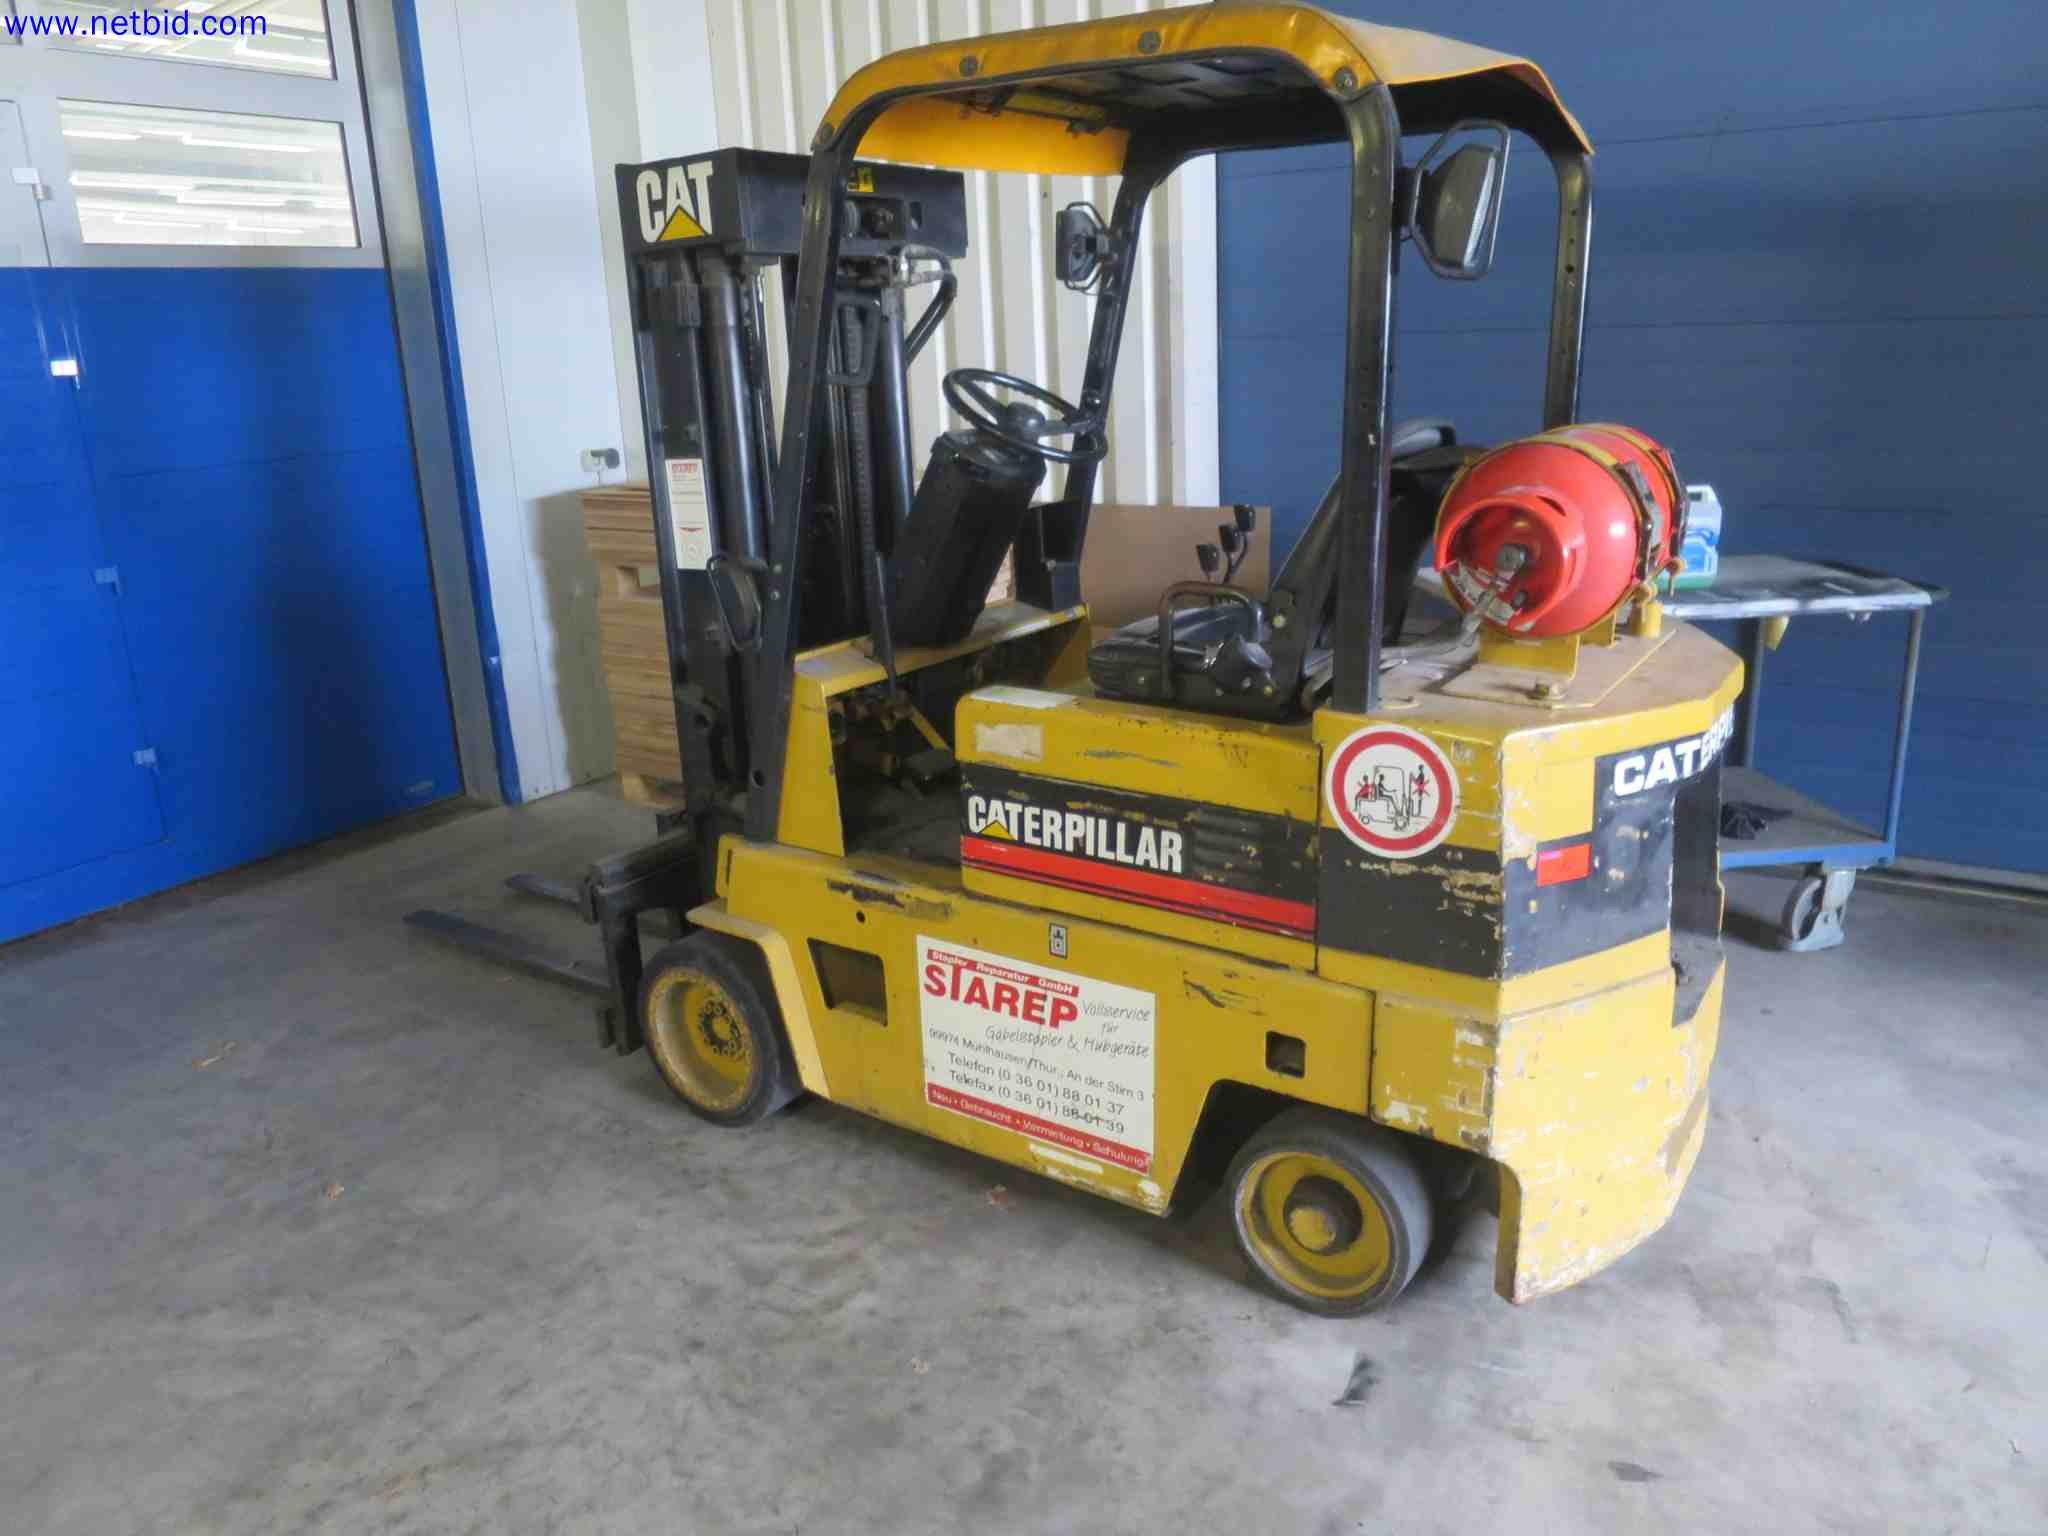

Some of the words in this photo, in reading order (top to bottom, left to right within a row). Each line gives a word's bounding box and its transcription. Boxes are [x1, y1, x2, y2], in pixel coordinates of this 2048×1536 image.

[636, 160, 714, 243] CAT
[967, 795, 1183, 874] CATERPILLAR
[924, 963, 1078, 1029] STAREP
[931, 949, 968, 968] Stapler
[976, 962, 1030, 984] Reparatur
[1037, 976, 1074, 995] GmbH
[1067, 1036, 1080, 1053] &
[948, 1051, 995, 1078] Telefon
[1016, 1071, 1034, 1088] 36
[1037, 1075, 1060, 1097] 01)
[1062, 1085, 1080, 1102] 88
[1085, 1091, 1101, 1108] 01
[1107, 1101, 1126, 1116] 37
[949, 1069, 995, 1093] Telefax
[1015, 1089, 1034, 1106] 36
[1036, 1093, 1060, 1117] 01)
[1066, 1068, 1082, 1082] An
[1084, 1074, 1104, 1089] der
[1022, 1119, 1085, 1148] Vermietung
[1092, 1141, 1147, 1169] Schulung
